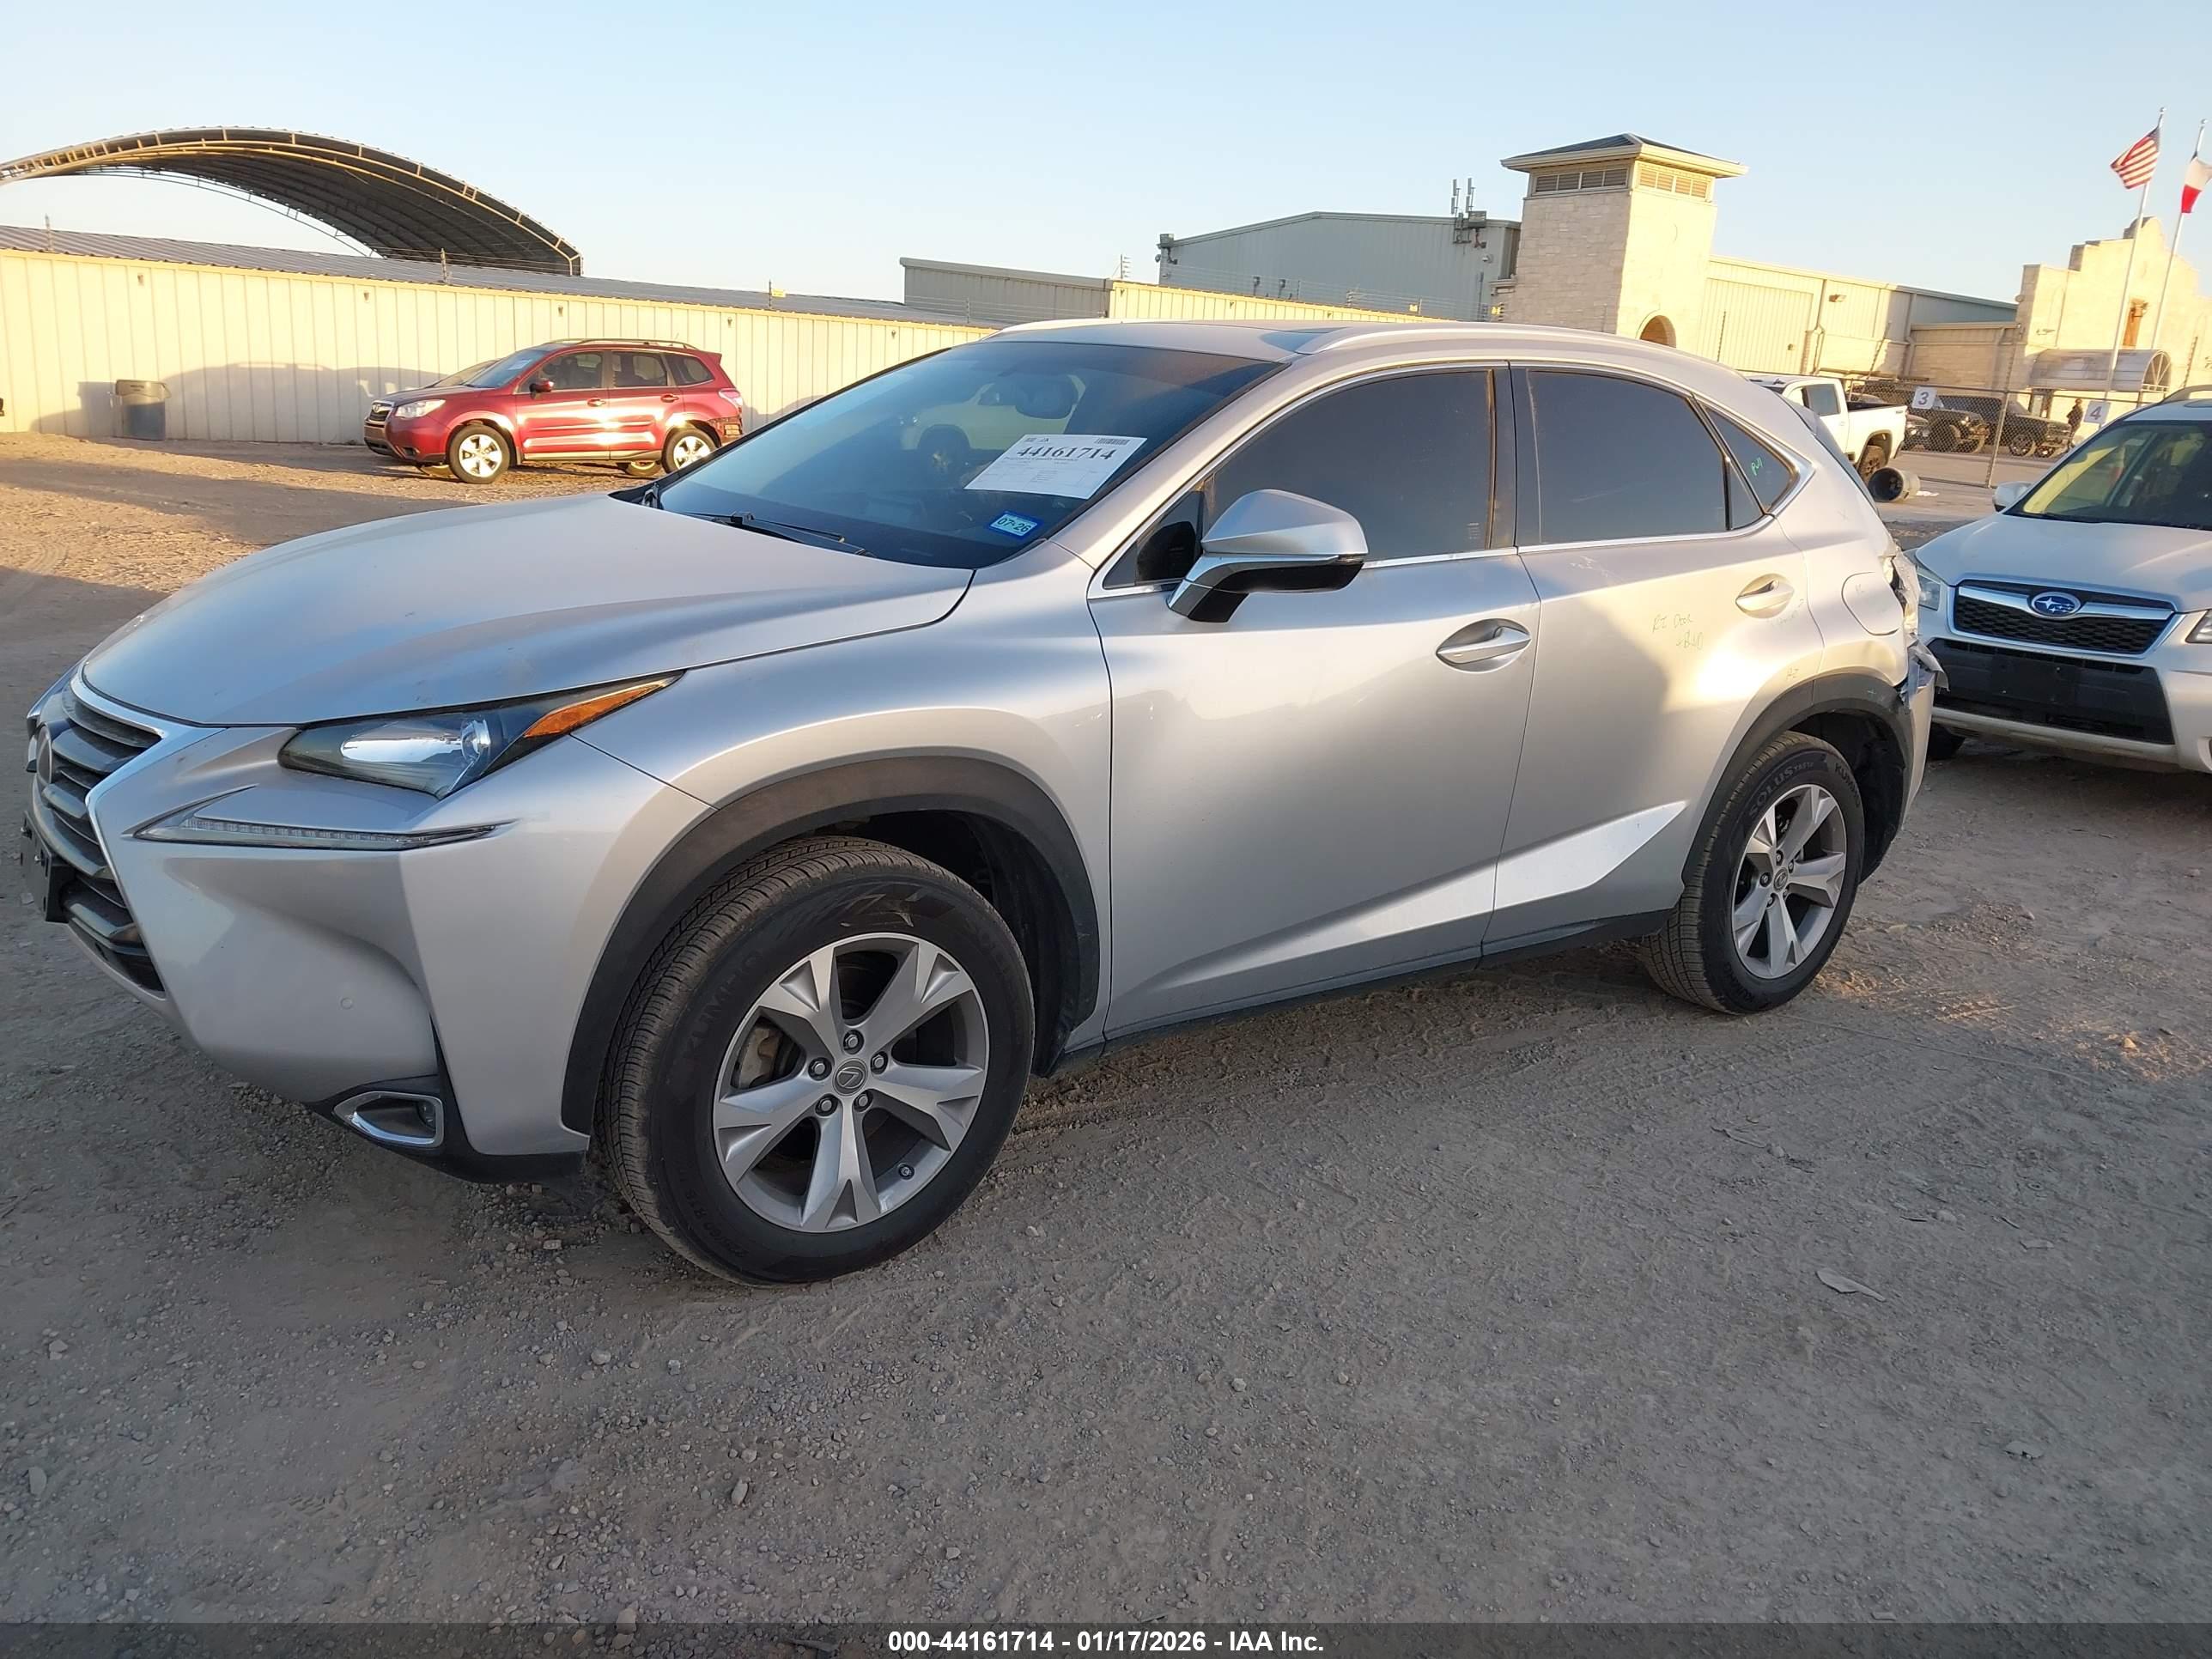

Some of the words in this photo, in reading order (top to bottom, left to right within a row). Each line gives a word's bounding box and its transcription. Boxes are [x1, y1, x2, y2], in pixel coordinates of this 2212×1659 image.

[1917, 392, 1929, 406] 3
[2089, 405, 2102, 421] 4
[1016, 446, 1117, 460] 44161714
